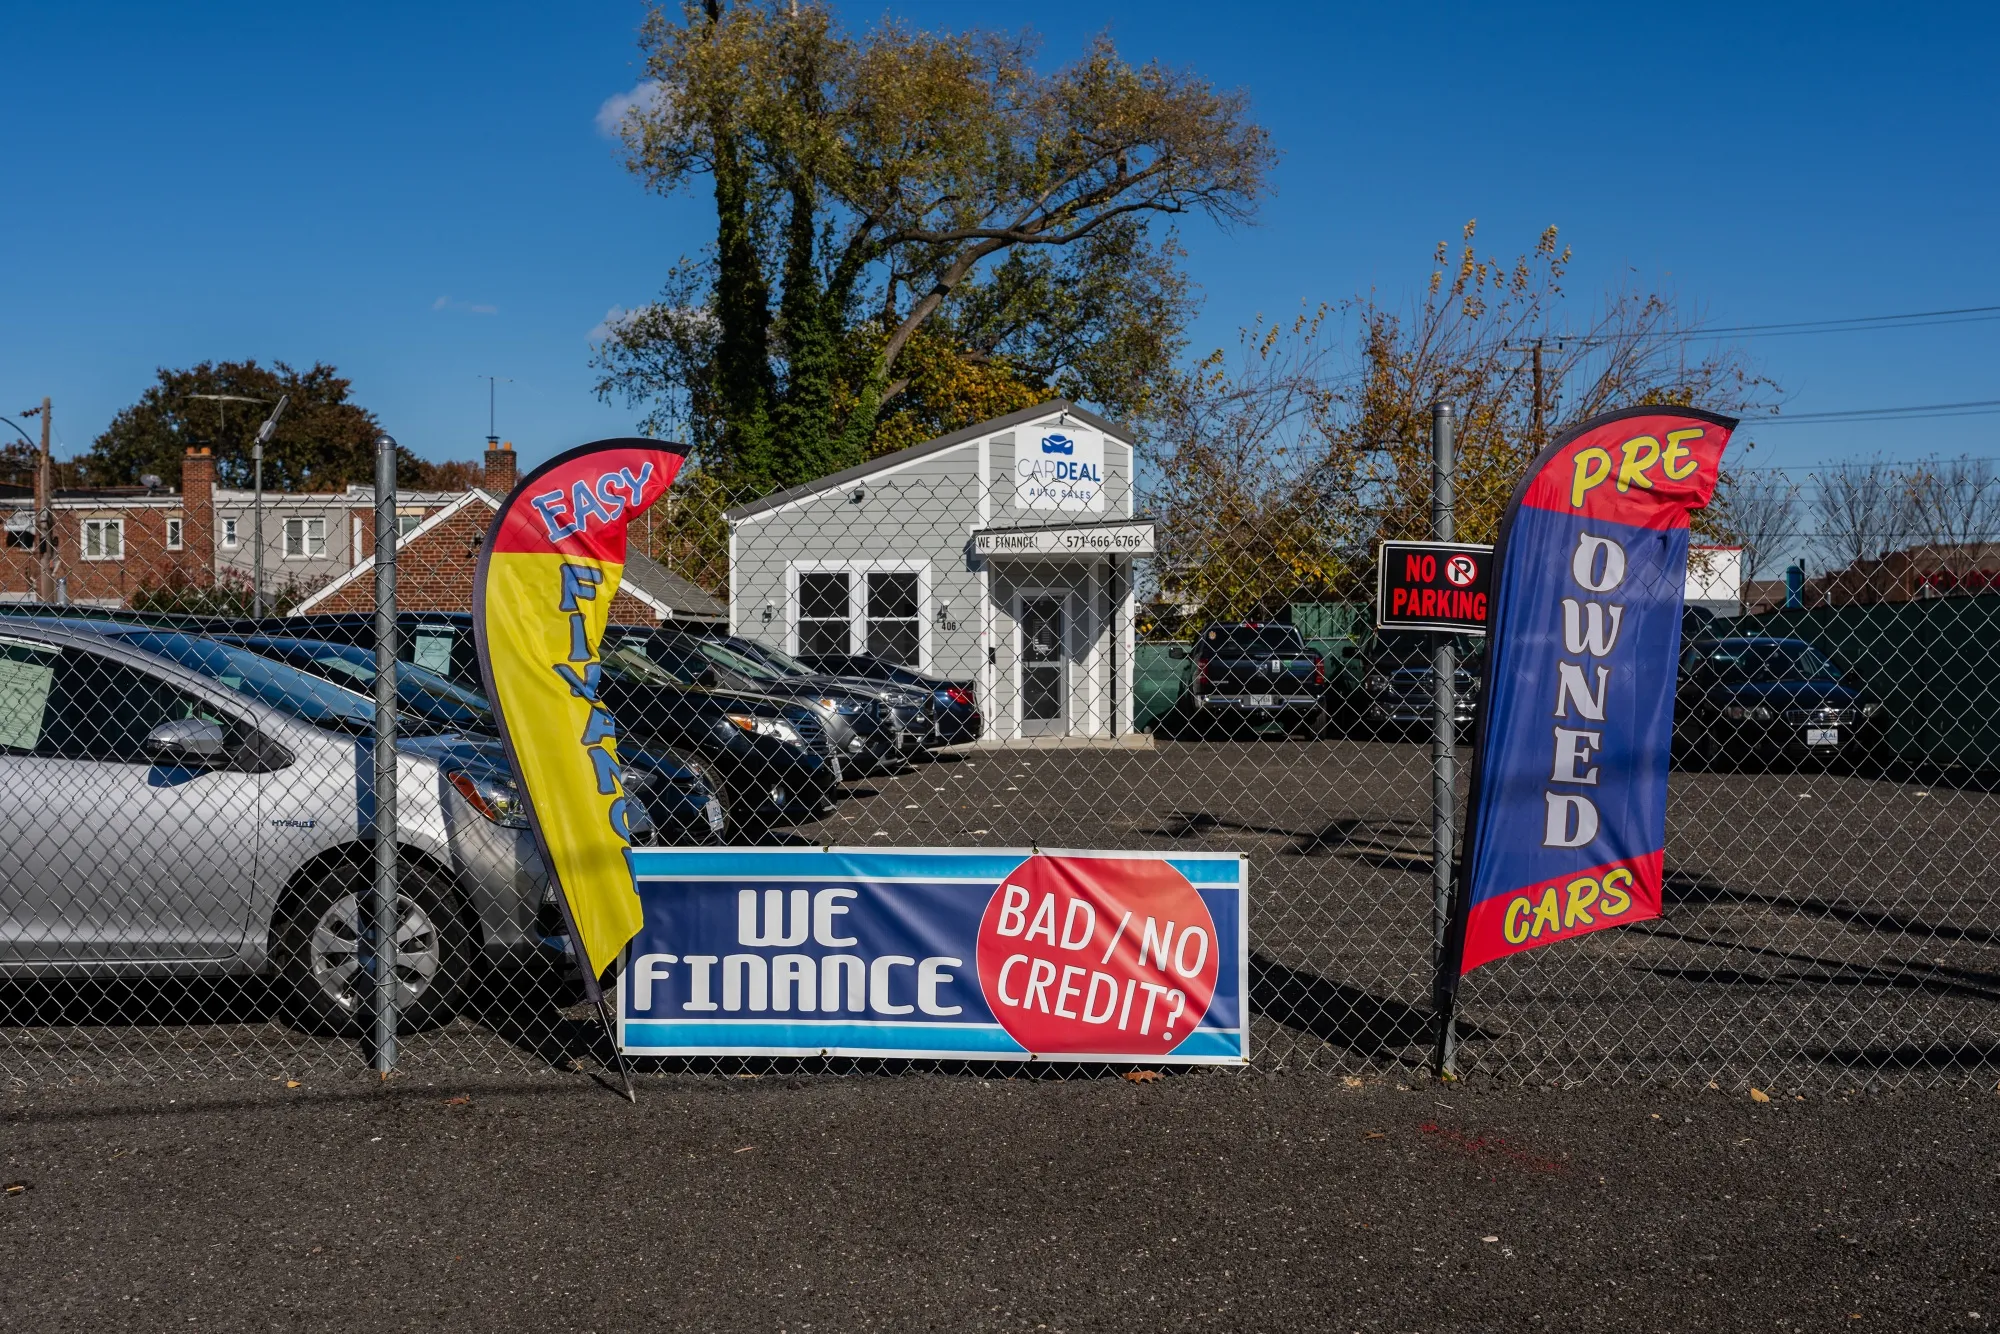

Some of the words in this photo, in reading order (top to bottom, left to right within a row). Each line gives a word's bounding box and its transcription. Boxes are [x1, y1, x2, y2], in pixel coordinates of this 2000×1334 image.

[1017, 459, 1101, 482] CARDEAL
[1029, 487, 1056, 498] AUTO
[1061, 488, 1091, 500] SALES
[1570, 427, 1705, 508] PRE
[531, 461, 654, 544] EASY
[977, 537, 990, 548] WE
[995, 536, 1038, 548] FINANCE!
[1066, 535, 1141, 548] 571-666-6766
[1406, 554, 1437, 582] NO
[941, 621, 957, 631] 406
[1393, 588, 1487, 620] PARKING
[1542, 531, 1626, 848] OWNED
[738, 888, 858, 948] WE
[996, 884, 1096, 951] BAD
[1101, 911, 1133, 965] /
[1138, 916, 1209, 979] NO
[1503, 867, 1633, 944] CARS
[633, 953, 963, 1017] FINANCE
[996, 953, 1186, 1042] CREDIT?
